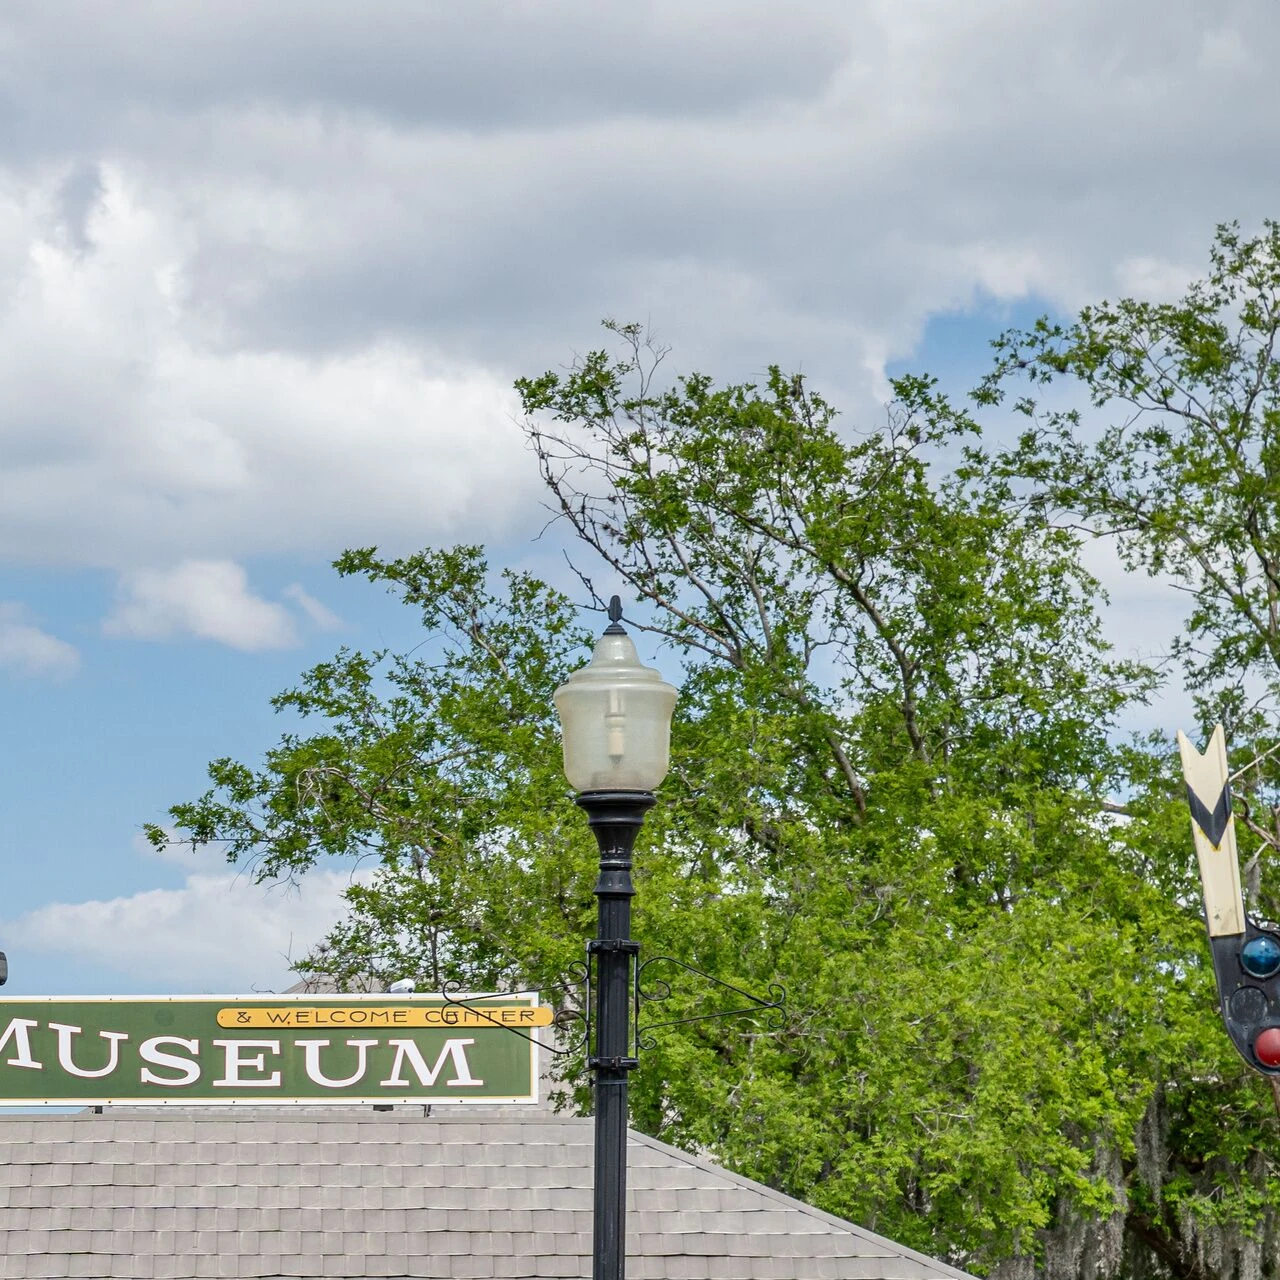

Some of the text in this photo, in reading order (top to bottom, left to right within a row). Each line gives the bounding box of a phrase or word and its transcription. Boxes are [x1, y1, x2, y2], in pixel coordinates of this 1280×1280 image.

[237, 1010, 536, 1024] & WELCOME CENTER
